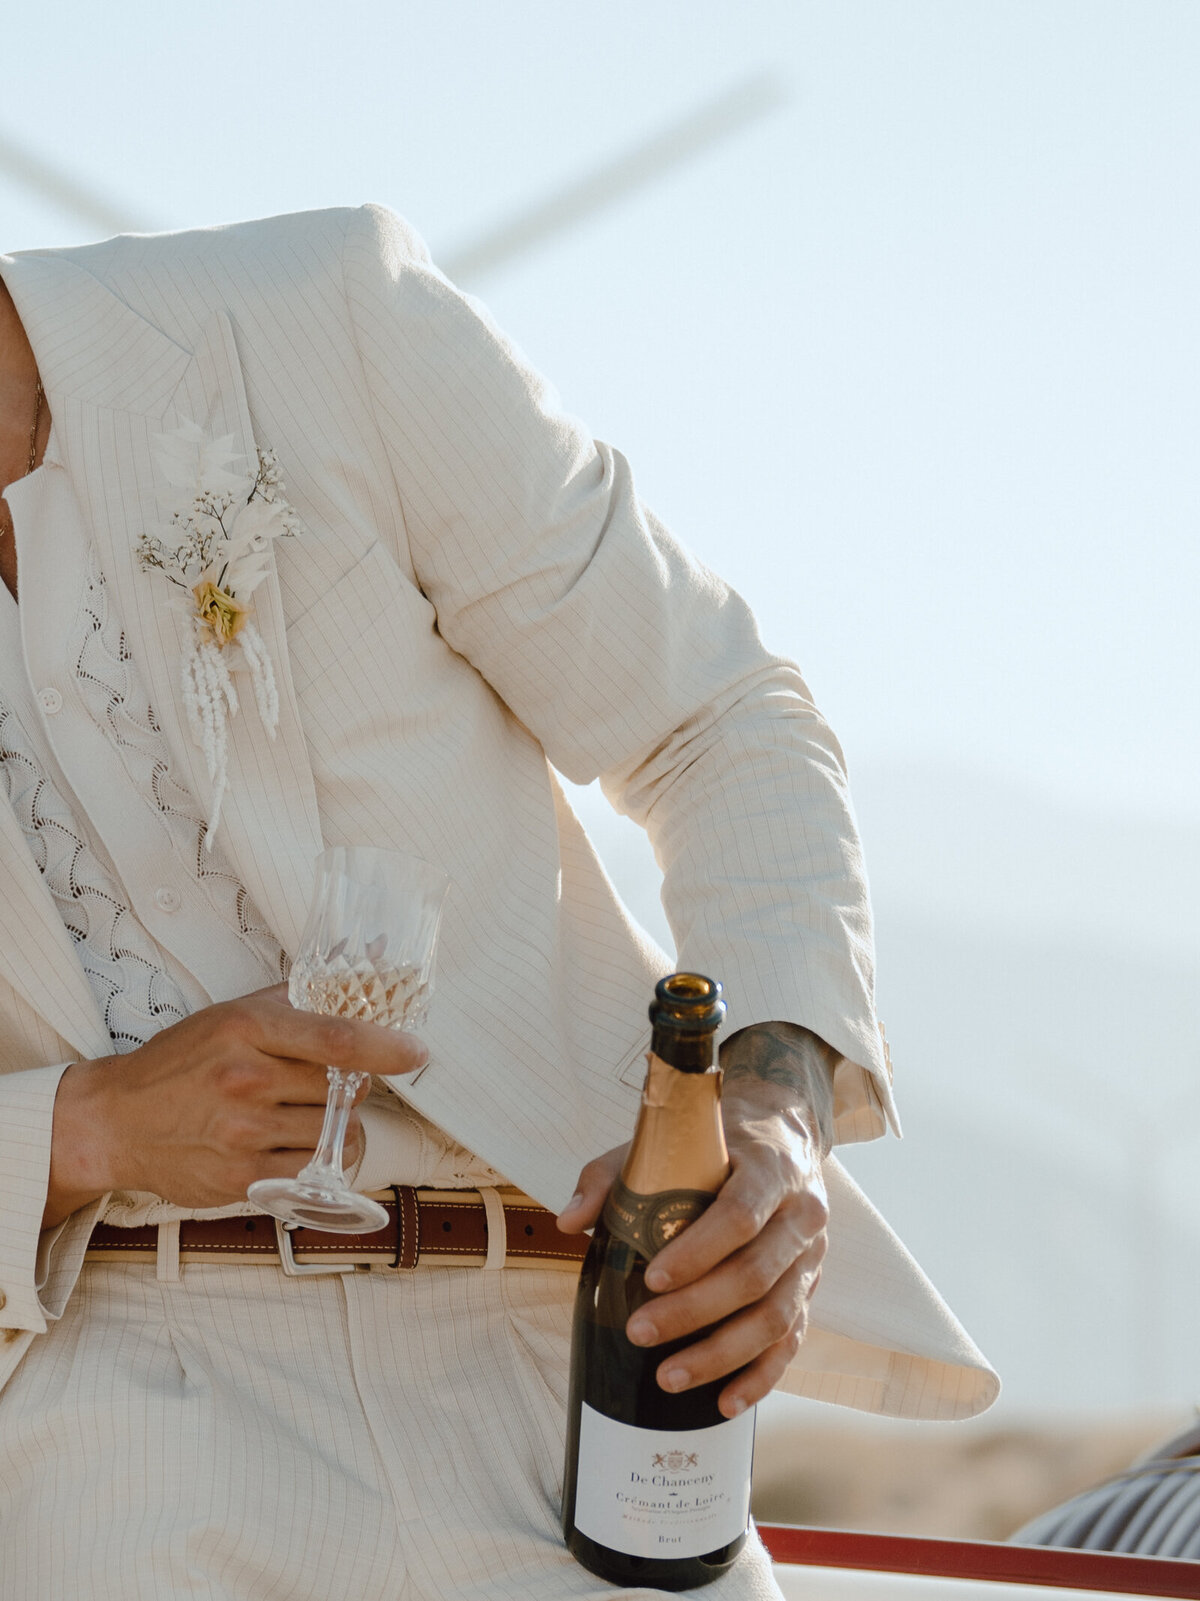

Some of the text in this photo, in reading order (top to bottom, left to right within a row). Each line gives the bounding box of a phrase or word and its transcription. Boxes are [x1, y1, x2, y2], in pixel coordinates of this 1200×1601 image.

[630, 1472, 714, 1487] De Chanceny
[616, 1492, 725, 1508] Crémant de Loire
